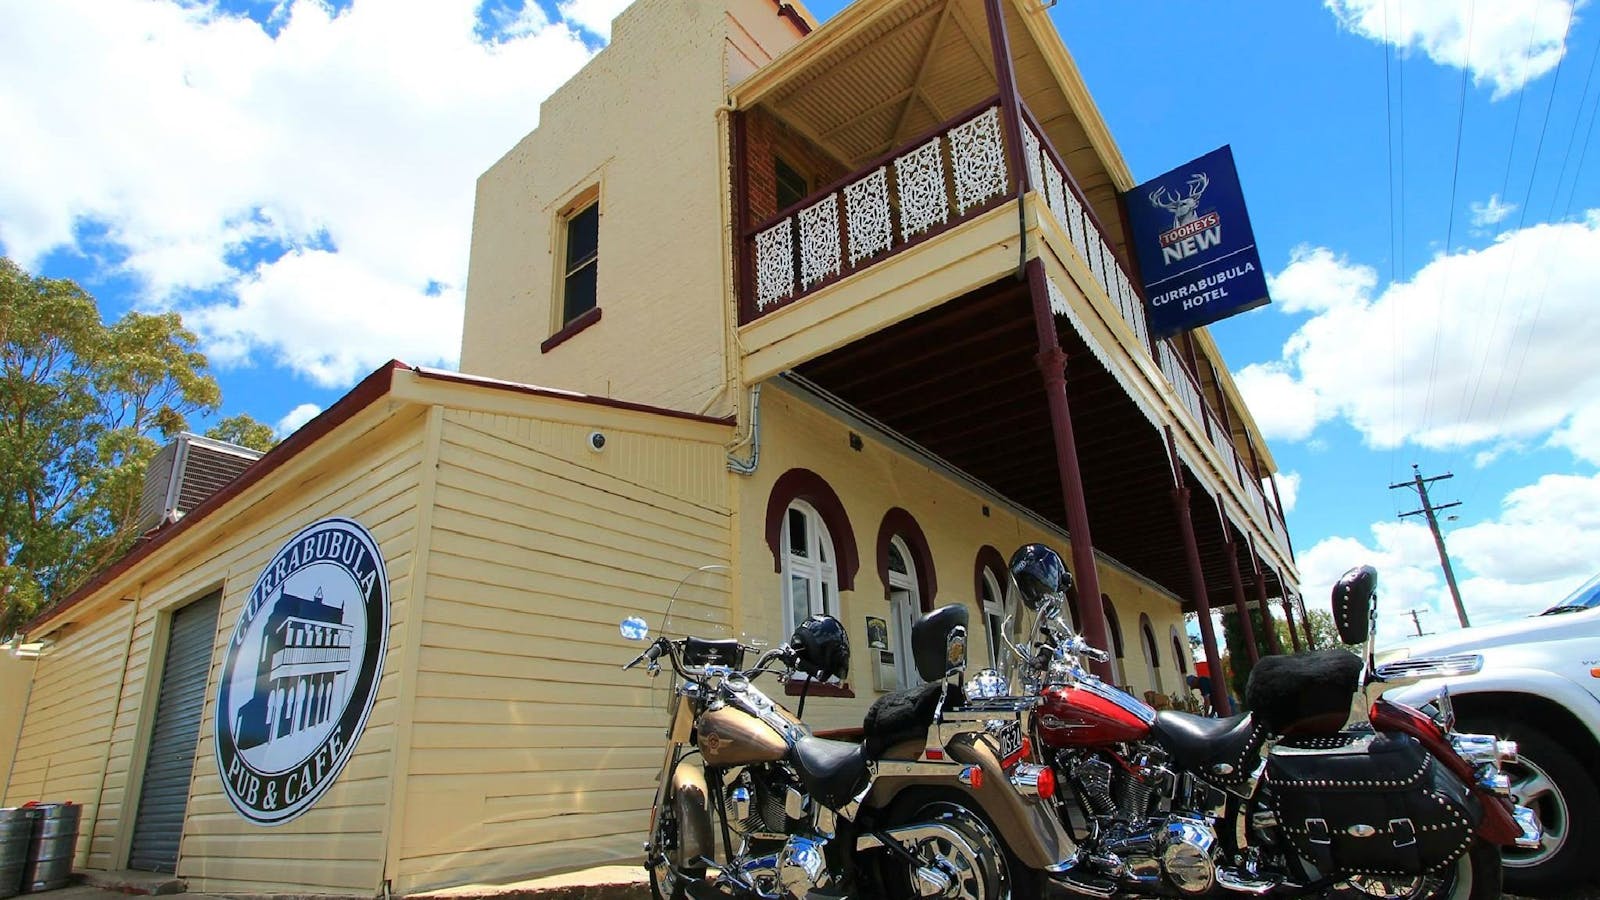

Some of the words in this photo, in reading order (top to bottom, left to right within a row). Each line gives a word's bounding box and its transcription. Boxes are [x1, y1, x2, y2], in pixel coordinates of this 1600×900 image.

[1161, 225, 1222, 267] NEW
[1162, 214, 1217, 244] TOOHEYS
[1152, 262, 1256, 307] CURRABUBULA
[1182, 287, 1229, 311] HOTEL
[235, 531, 377, 646] CURRABUBULA
[227, 752, 261, 806] PUB
[262, 780, 279, 810] &
[285, 725, 344, 805] CAFE
